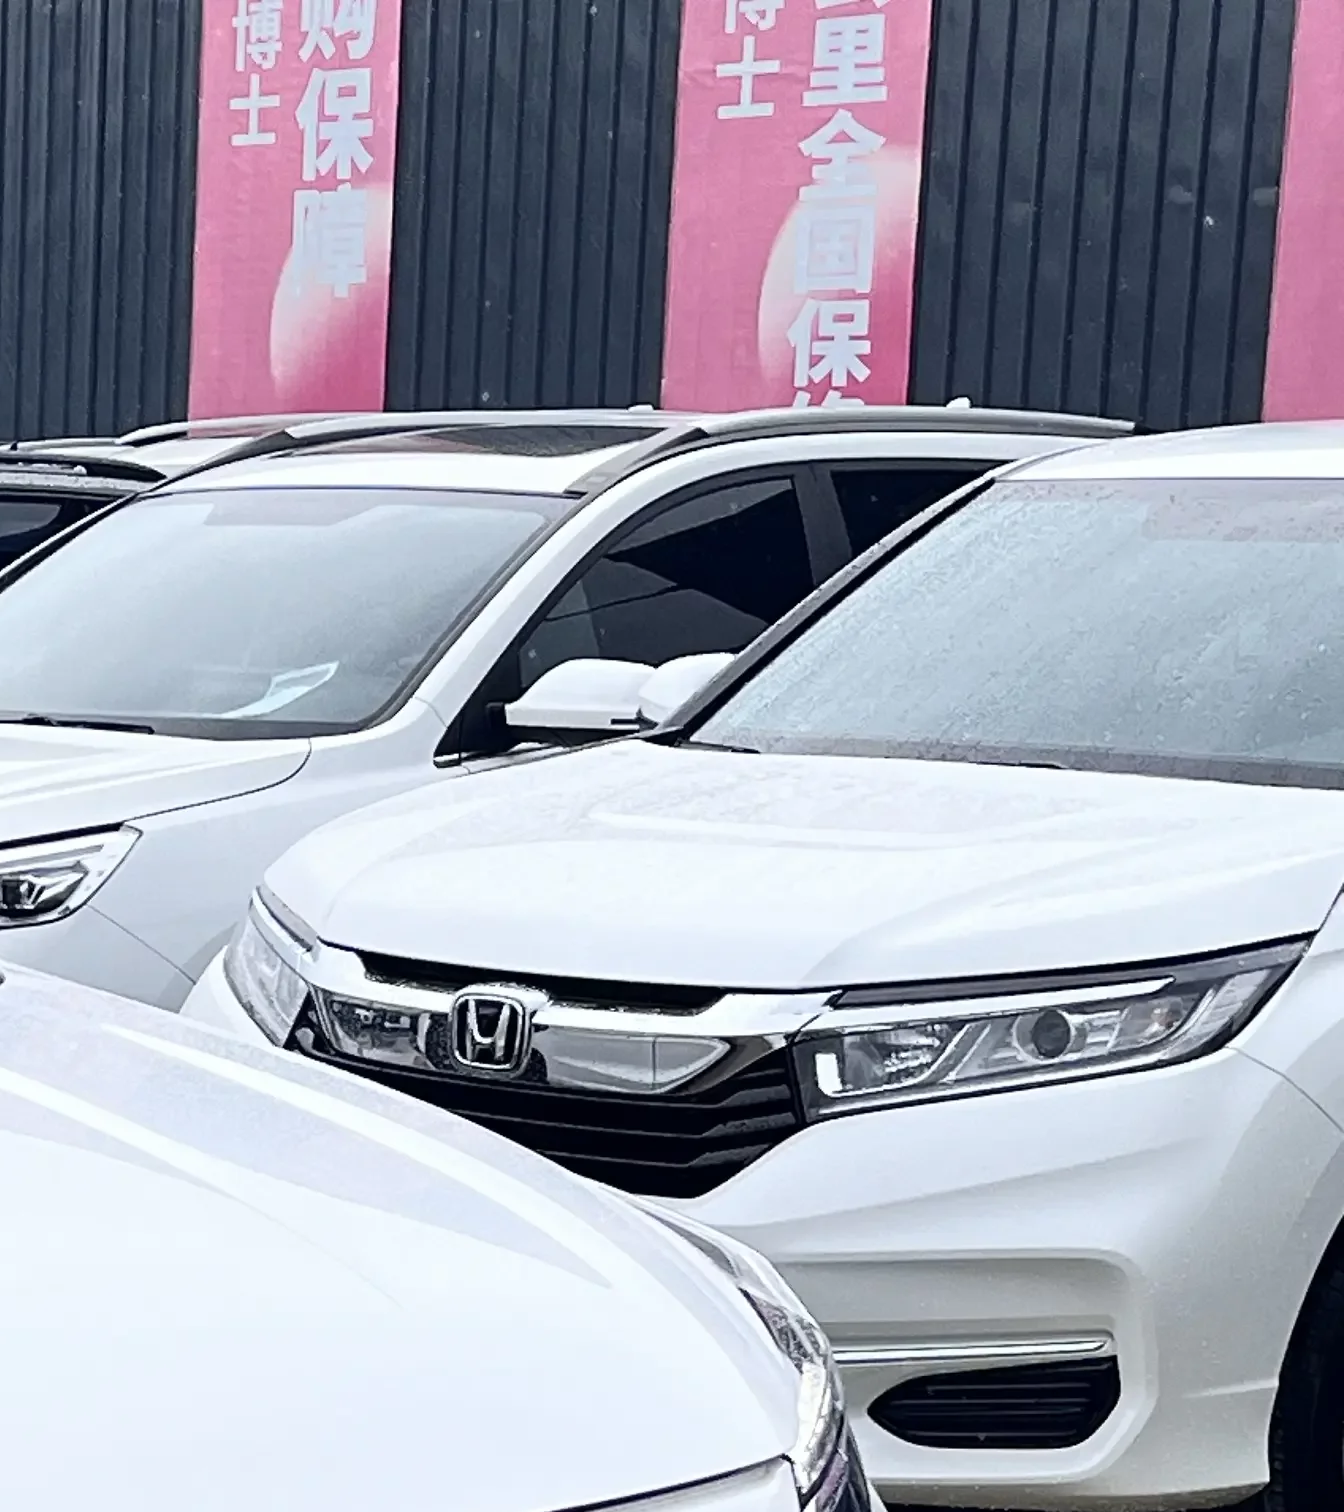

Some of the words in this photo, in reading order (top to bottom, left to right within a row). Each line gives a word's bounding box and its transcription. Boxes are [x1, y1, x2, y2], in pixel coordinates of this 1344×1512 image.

[229, 0, 283, 146] 博士
[786, 0, 888, 408] 里全国保
